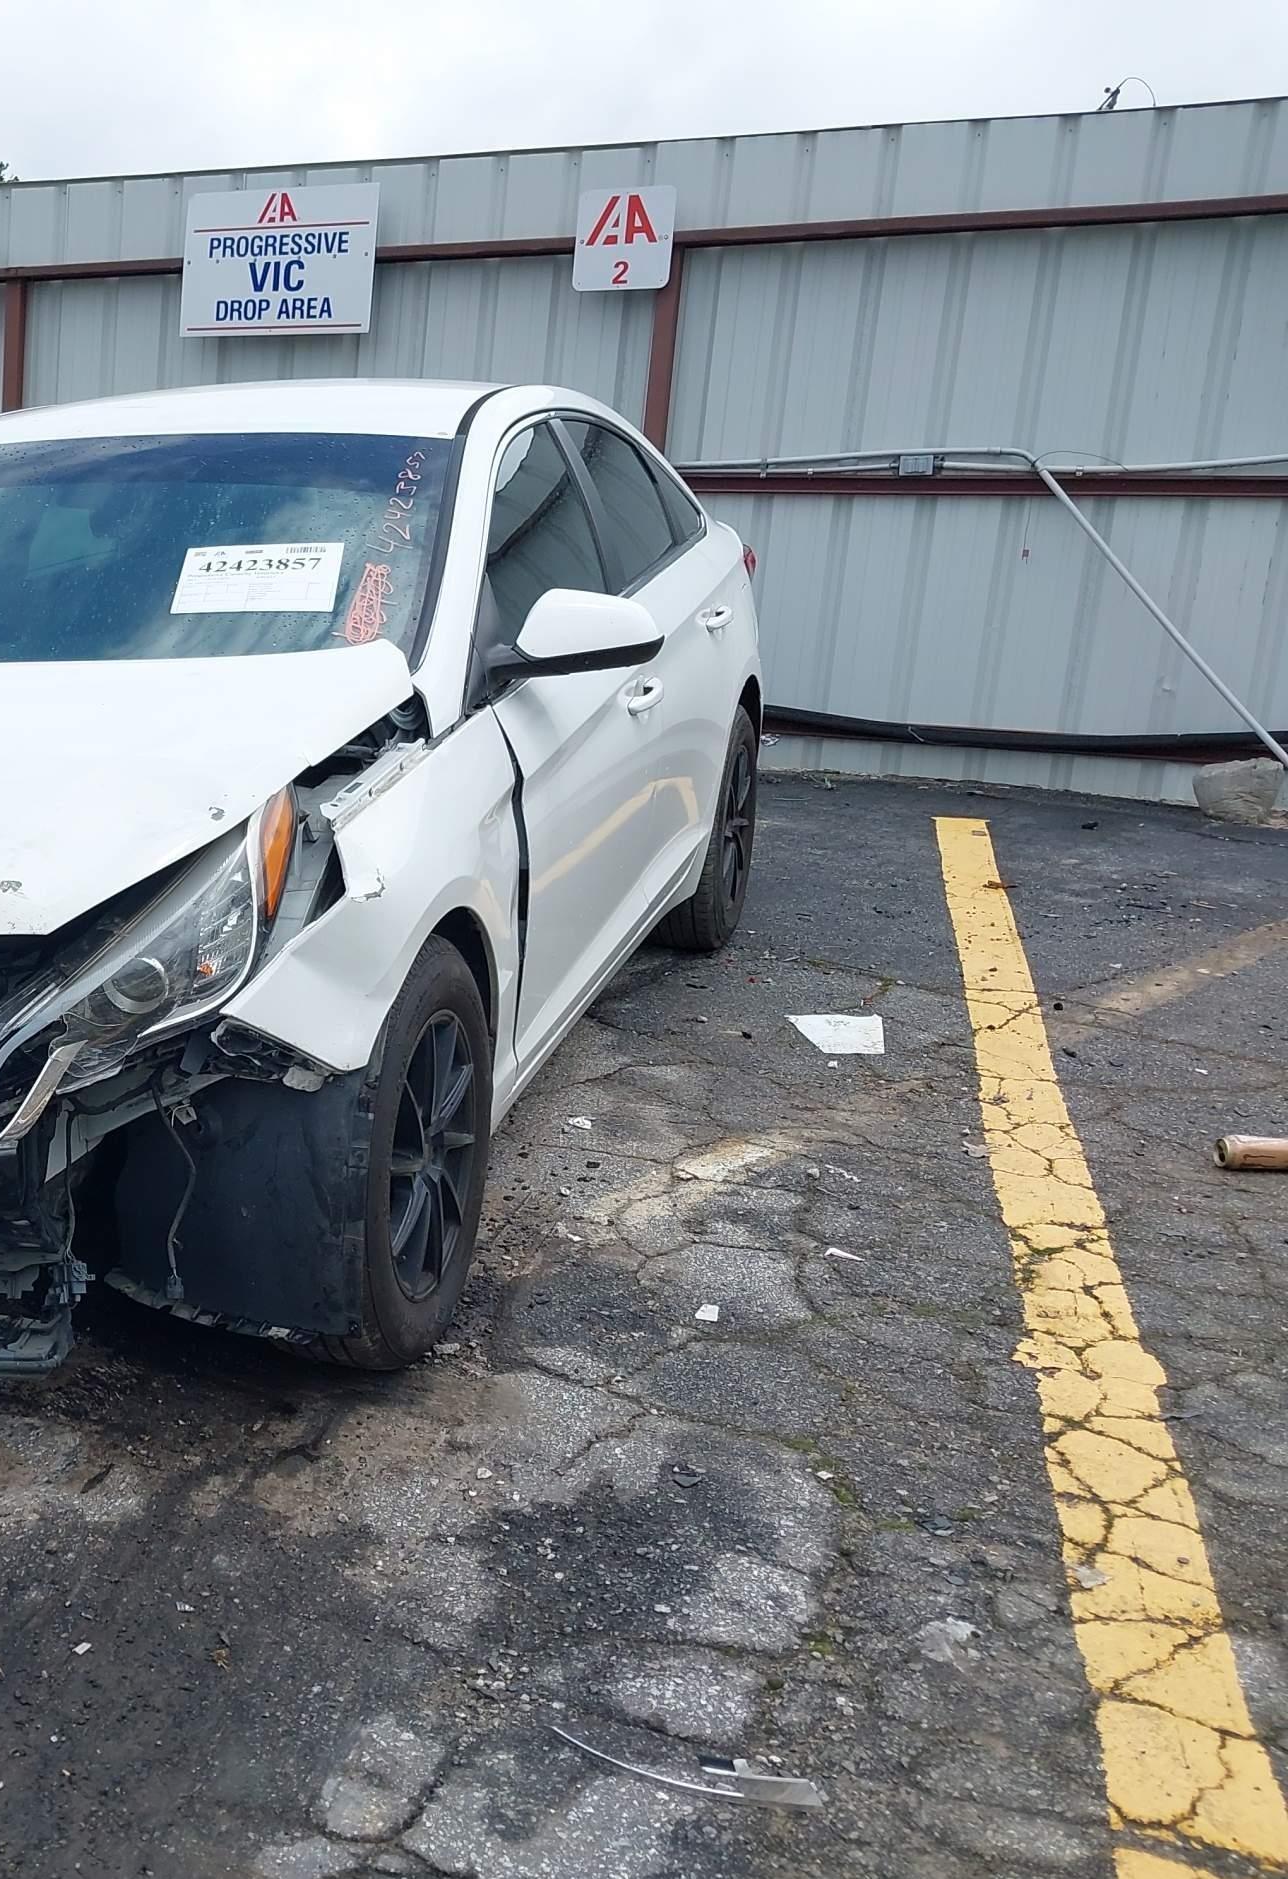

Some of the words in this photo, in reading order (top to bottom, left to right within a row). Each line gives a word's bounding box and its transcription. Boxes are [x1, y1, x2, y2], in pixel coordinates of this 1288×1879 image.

[209, 231, 349, 259] PROGRESSIVE
[248, 259, 305, 293] VIC
[612, 260, 629, 285] 2
[215, 299, 271, 322] DROP
[277, 296, 333, 321] AREA
[365, 451, 426, 554] 42423857
[198, 557, 322, 573] 42423857
